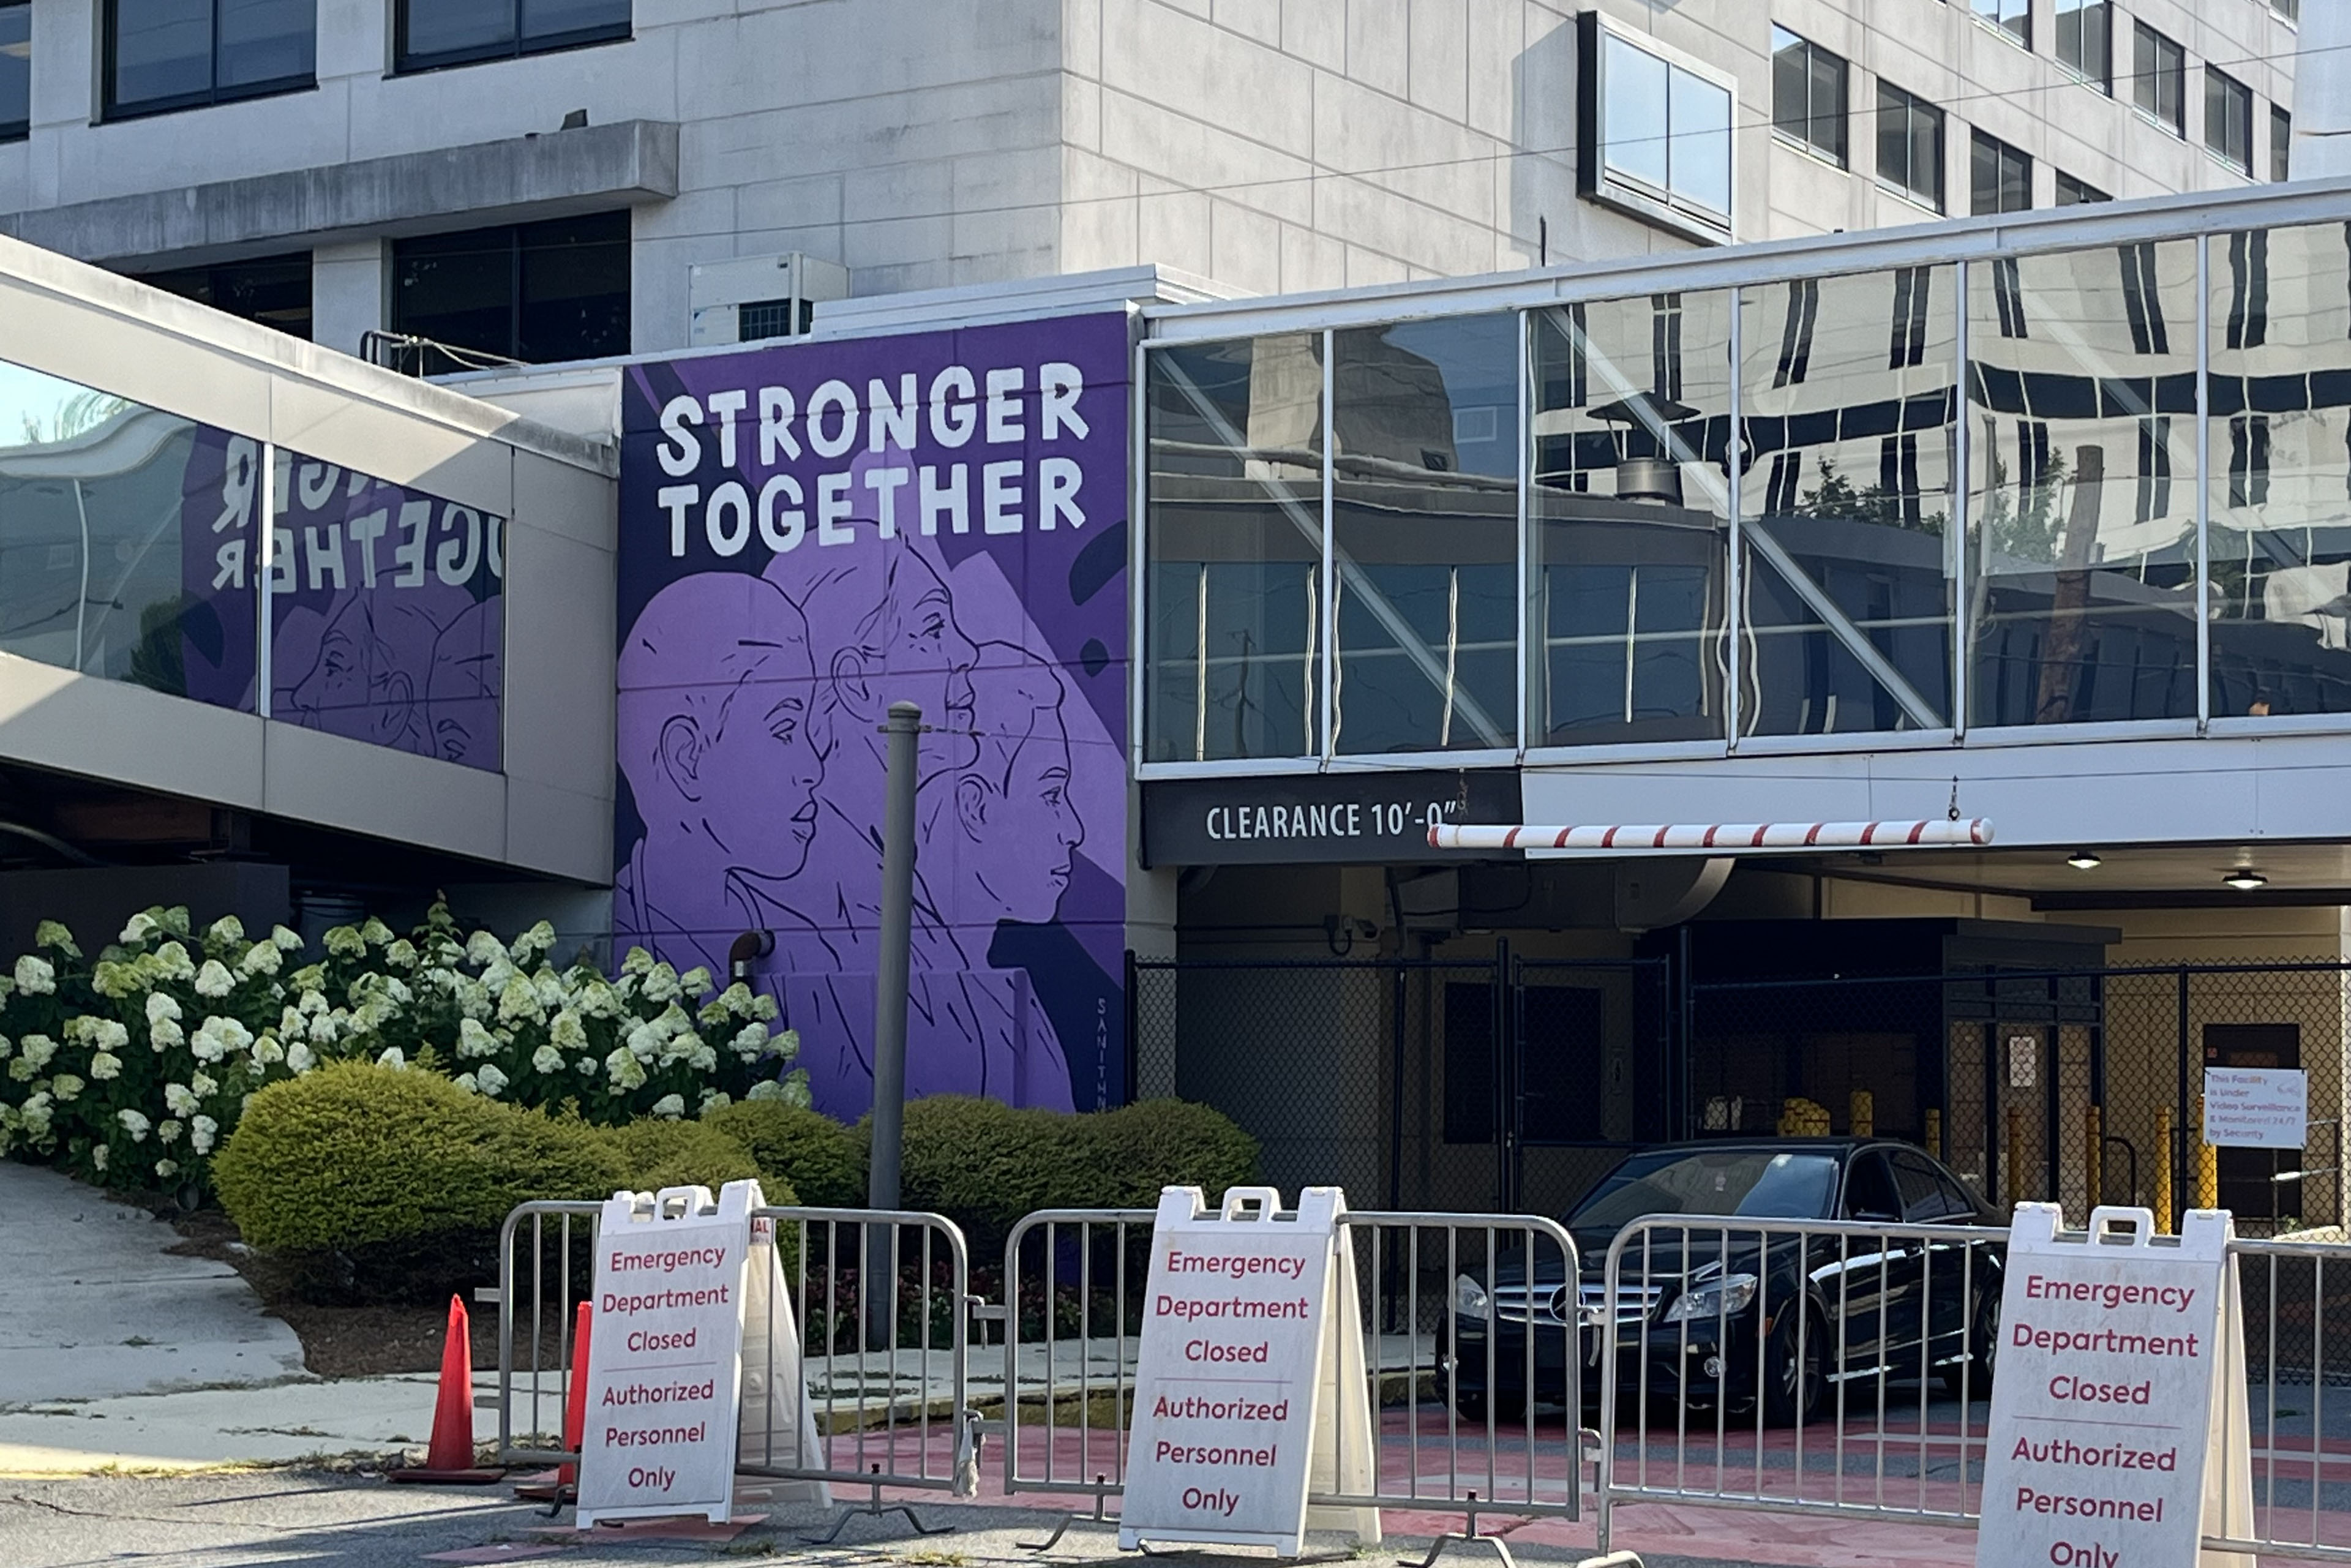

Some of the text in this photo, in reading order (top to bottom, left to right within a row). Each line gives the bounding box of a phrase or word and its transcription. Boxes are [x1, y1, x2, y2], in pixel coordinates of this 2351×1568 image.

[657, 362, 1089, 477] STRONGER
[658, 457, 1086, 557] TOGETHER
[1207, 804, 1360, 839] CLEARANCE
[2211, 1075, 2268, 1086] This Facility
[2210, 1102, 2301, 1112] Video Surveillance
[2219, 1115, 2270, 1124] Monitored
[2273, 1116, 2296, 1125] 24/7
[2209, 1128, 2264, 1140] by Security
[610, 1246, 726, 1273] Emergency
[1168, 1251, 1306, 1278] Emergency
[602, 1284, 729, 1316] Department
[2027, 1275, 2195, 1313] Emergency
[1156, 1296, 1309, 1322] Department
[628, 1327, 696, 1352] Closed
[1185, 1340, 1269, 1363] Closed
[2013, 1323, 2199, 1357] Department
[602, 1379, 714, 1406] Authorized
[2049, 1376, 2151, 1405] Closed
[1153, 1396, 1289, 1421] Authorized
[606, 1422, 706, 1447] Personnel
[1156, 1441, 1277, 1466] Personnel
[2011, 1436, 2177, 1471] Authorized
[628, 1466, 676, 1492] Only
[1182, 1487, 1239, 1517] Only
[2017, 1488, 2163, 1522] Personnel
[2050, 1541, 2119, 1568] Only
